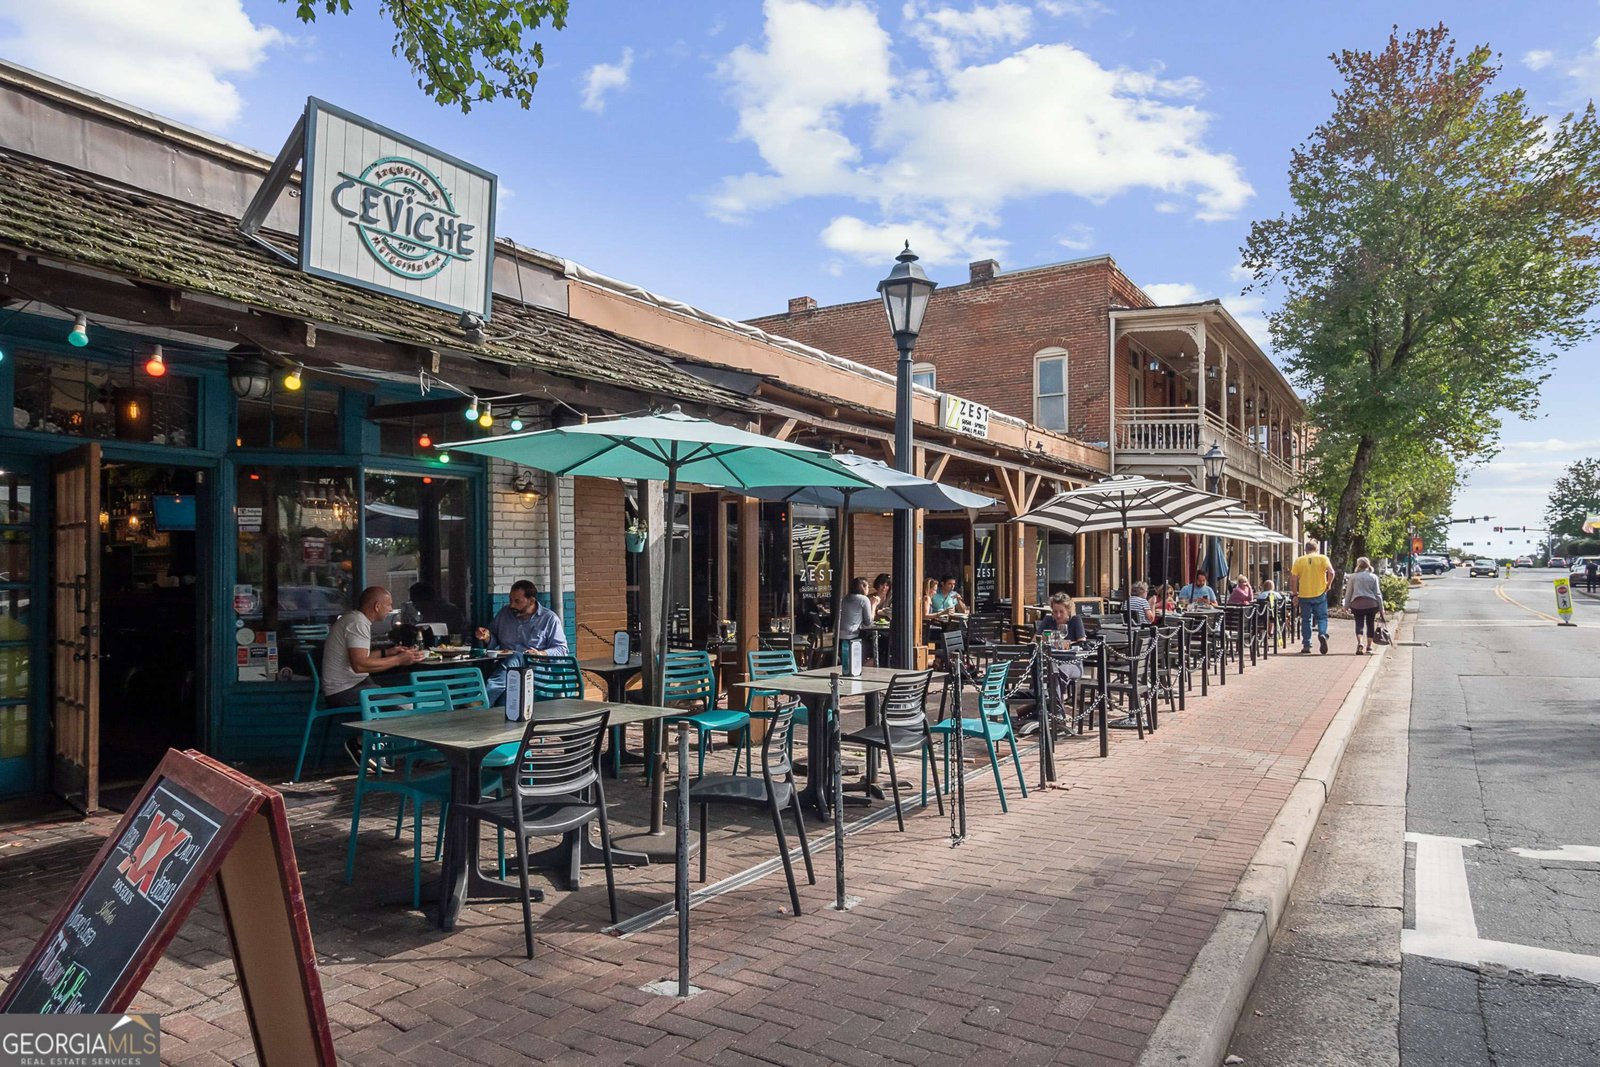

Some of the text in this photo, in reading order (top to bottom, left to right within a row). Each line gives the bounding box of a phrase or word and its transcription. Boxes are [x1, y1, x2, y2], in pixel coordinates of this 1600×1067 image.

[960, 401, 989, 422] ZEST
[800, 569, 833, 582] ZEST
[977, 568, 995, 577] ZEST
[111, 877, 135, 904] DOS EQUIS
